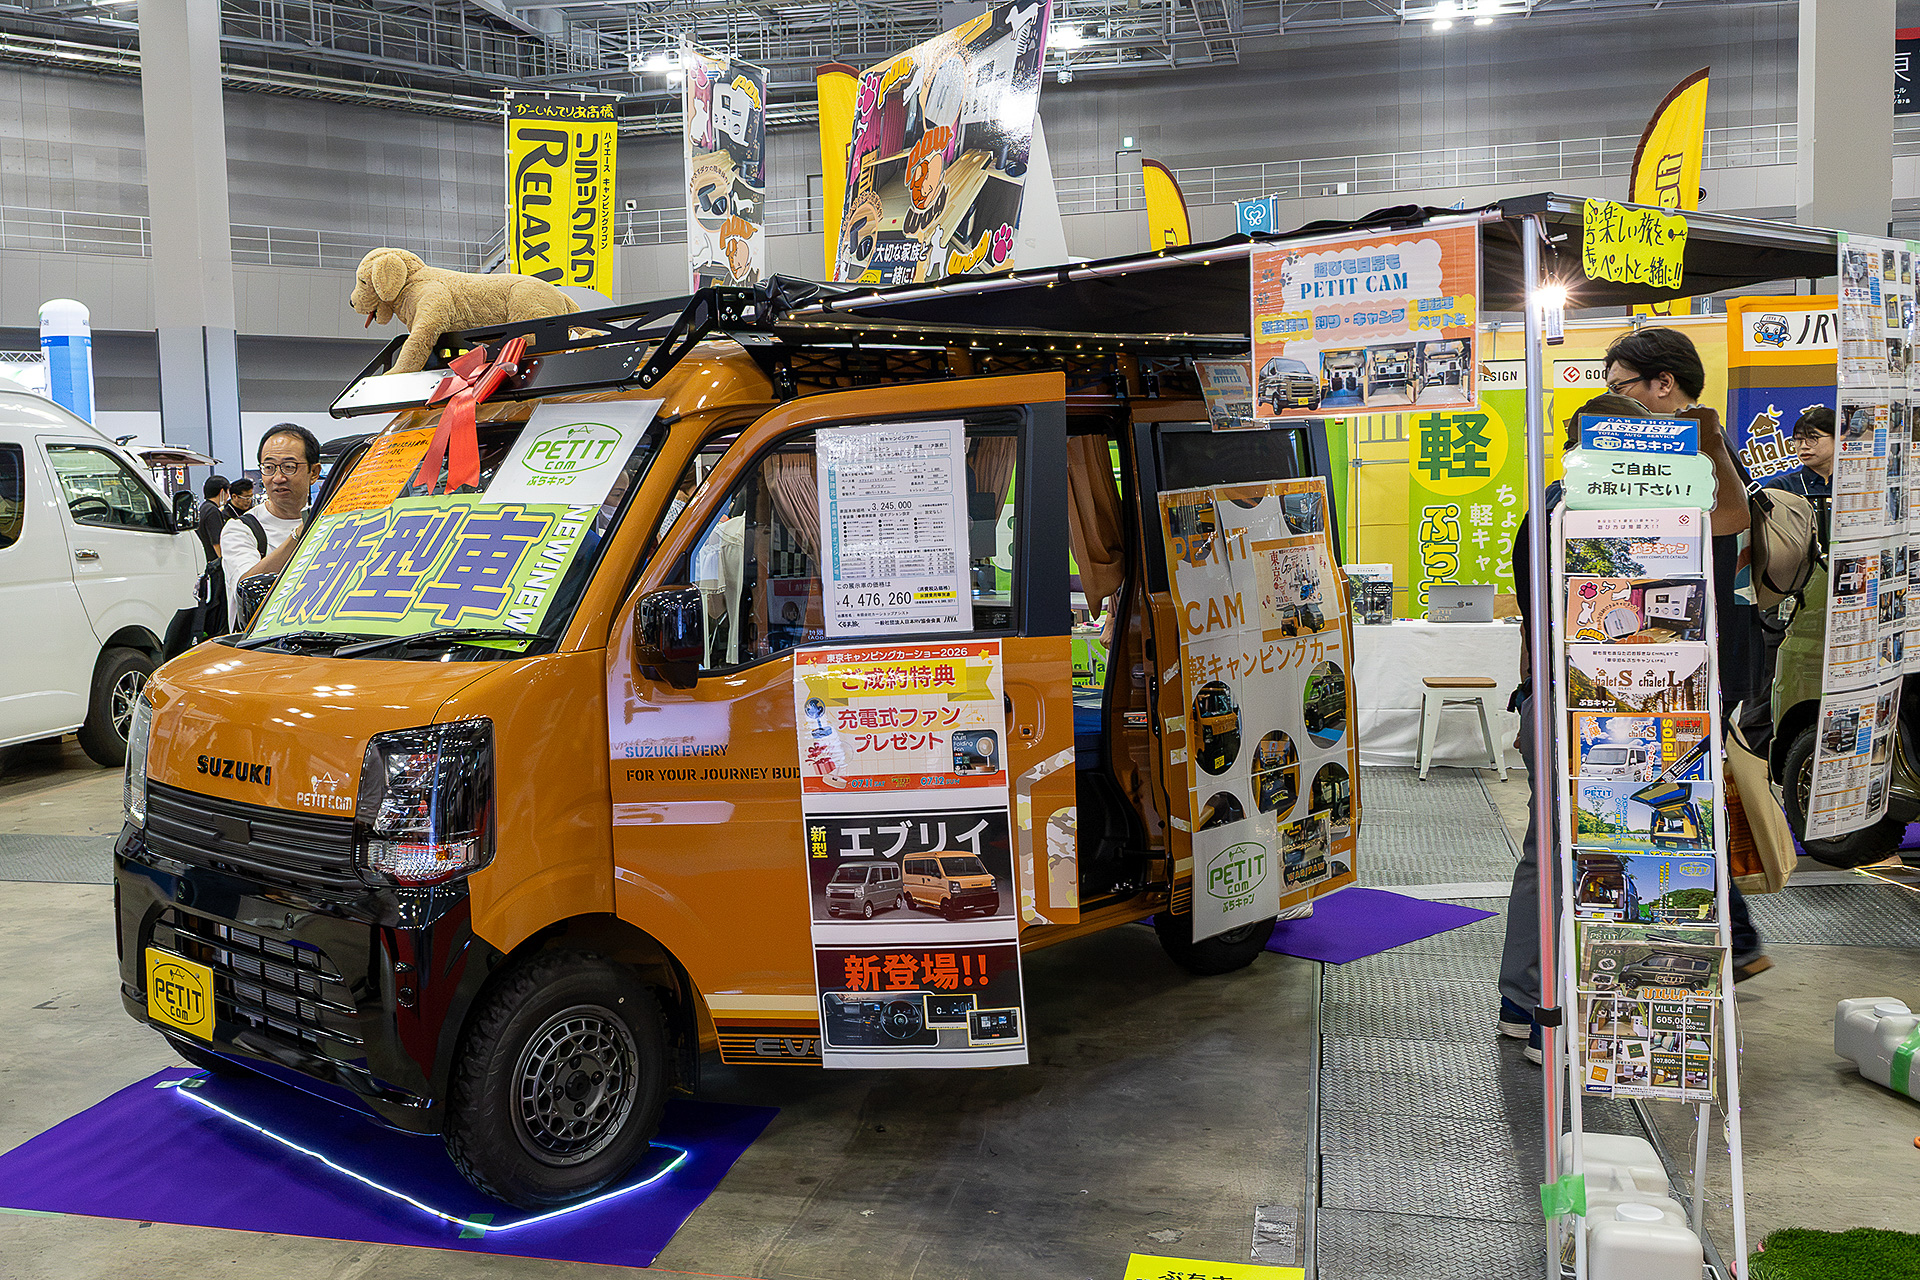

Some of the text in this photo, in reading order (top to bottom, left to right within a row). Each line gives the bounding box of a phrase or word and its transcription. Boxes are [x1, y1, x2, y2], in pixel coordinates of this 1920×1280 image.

[571, 132, 599, 289] リラックスワ
[1598, 201, 1665, 247] 楽しい旅を
[1585, 201, 1598, 278] ぷちキャン
[874, 242, 928, 262] 大切な家族と
[1300, 272, 1408, 300] PETIT CAM
[1796, 314, 1839, 345] JR
[1602, 424, 1676, 434] ASSIST
[526, 439, 616, 460] PETIT
[1418, 412, 1492, 481] 軽
[1623, 439, 1685, 452] ぷちキャン
[1611, 462, 1672, 476] ご自由に
[1629, 542, 1690, 554] ぷちキャン
[281, 503, 555, 627] 新型車
[842, 591, 912, 608] 4,476,260
[1185, 592, 1245, 636] CAM
[826, 647, 968, 664] 東京キャンピングカーショー2026
[1187, 637, 1340, 687] 軽キャンピングカー
[840, 663, 956, 691] ご成約特典
[1638, 676, 1666, 688] chalet
[837, 705, 961, 730] 充電式ファン
[1676, 719, 1701, 728] NEW
[625, 744, 729, 758] SUZUKI EVERY
[854, 732, 944, 753] プレゼント
[196, 754, 272, 786] SUZUKI
[626, 769, 655, 781] FOR
[657, 768, 698, 781] YOUR
[700, 767, 769, 780] JOURNEY
[920, 776, 944, 787] 07.12
[851, 778, 873, 789] 07.11
[296, 791, 327, 808] PETIT
[810, 825, 828, 859] 新型
[839, 818, 989, 859] エブリイ
[1209, 853, 1265, 890] PETIT
[844, 953, 989, 991] 新登場!!
[155, 977, 202, 1014] PETIT
[1654, 1005, 1684, 1013] VILLA
